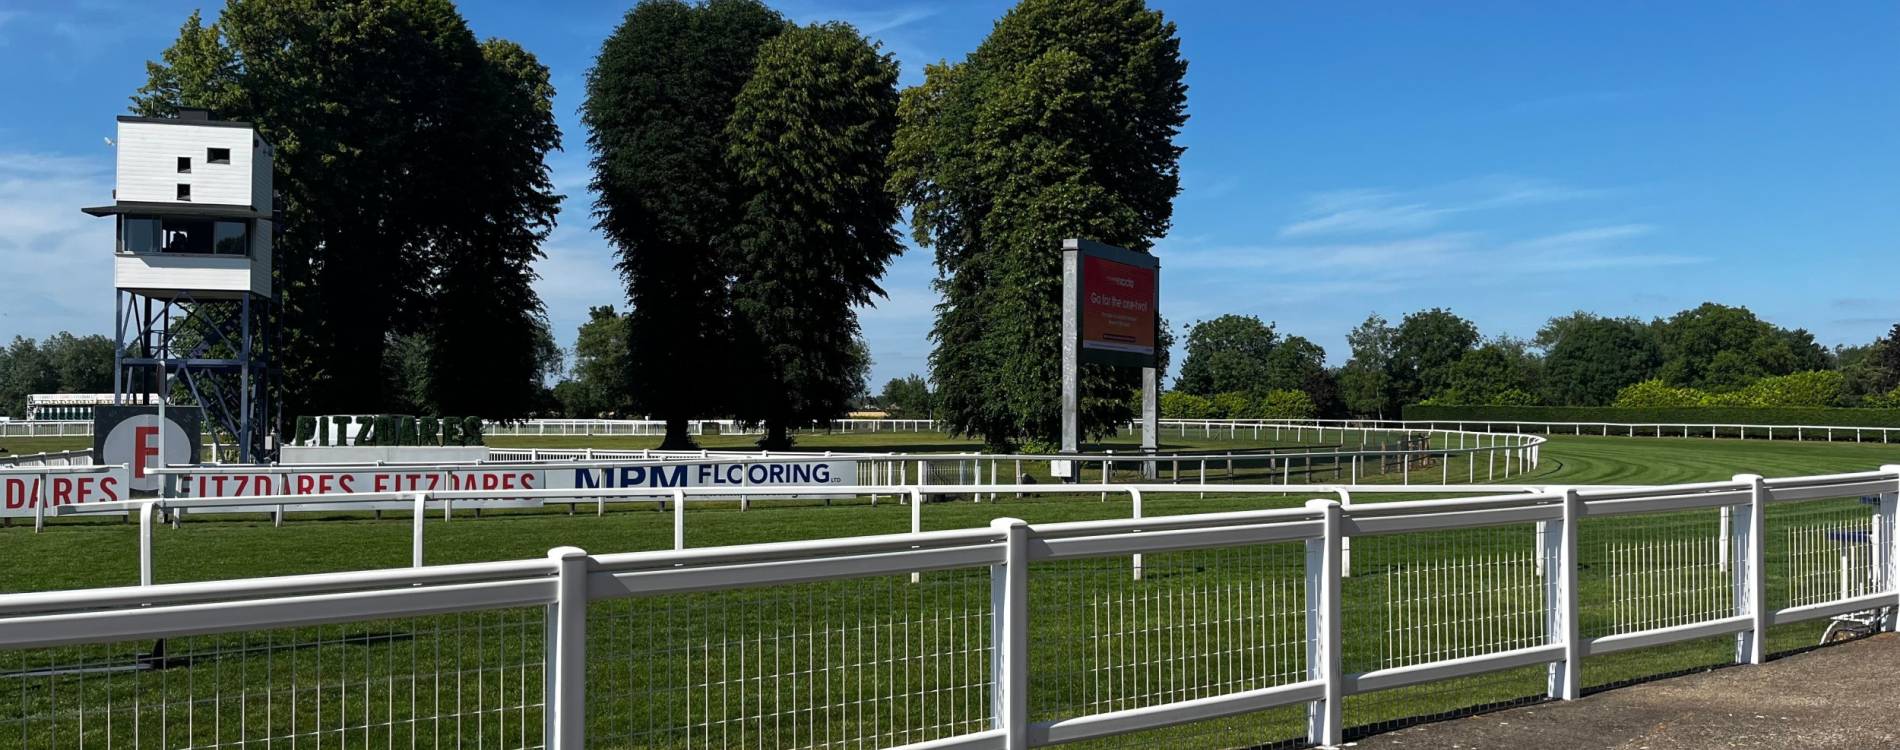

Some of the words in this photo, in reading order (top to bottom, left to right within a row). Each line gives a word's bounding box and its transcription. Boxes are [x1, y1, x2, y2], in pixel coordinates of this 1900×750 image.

[296, 415, 482, 447] FITZDARES
[698, 464, 830, 484] FLOORING
[6, 477, 118, 508] DARES
